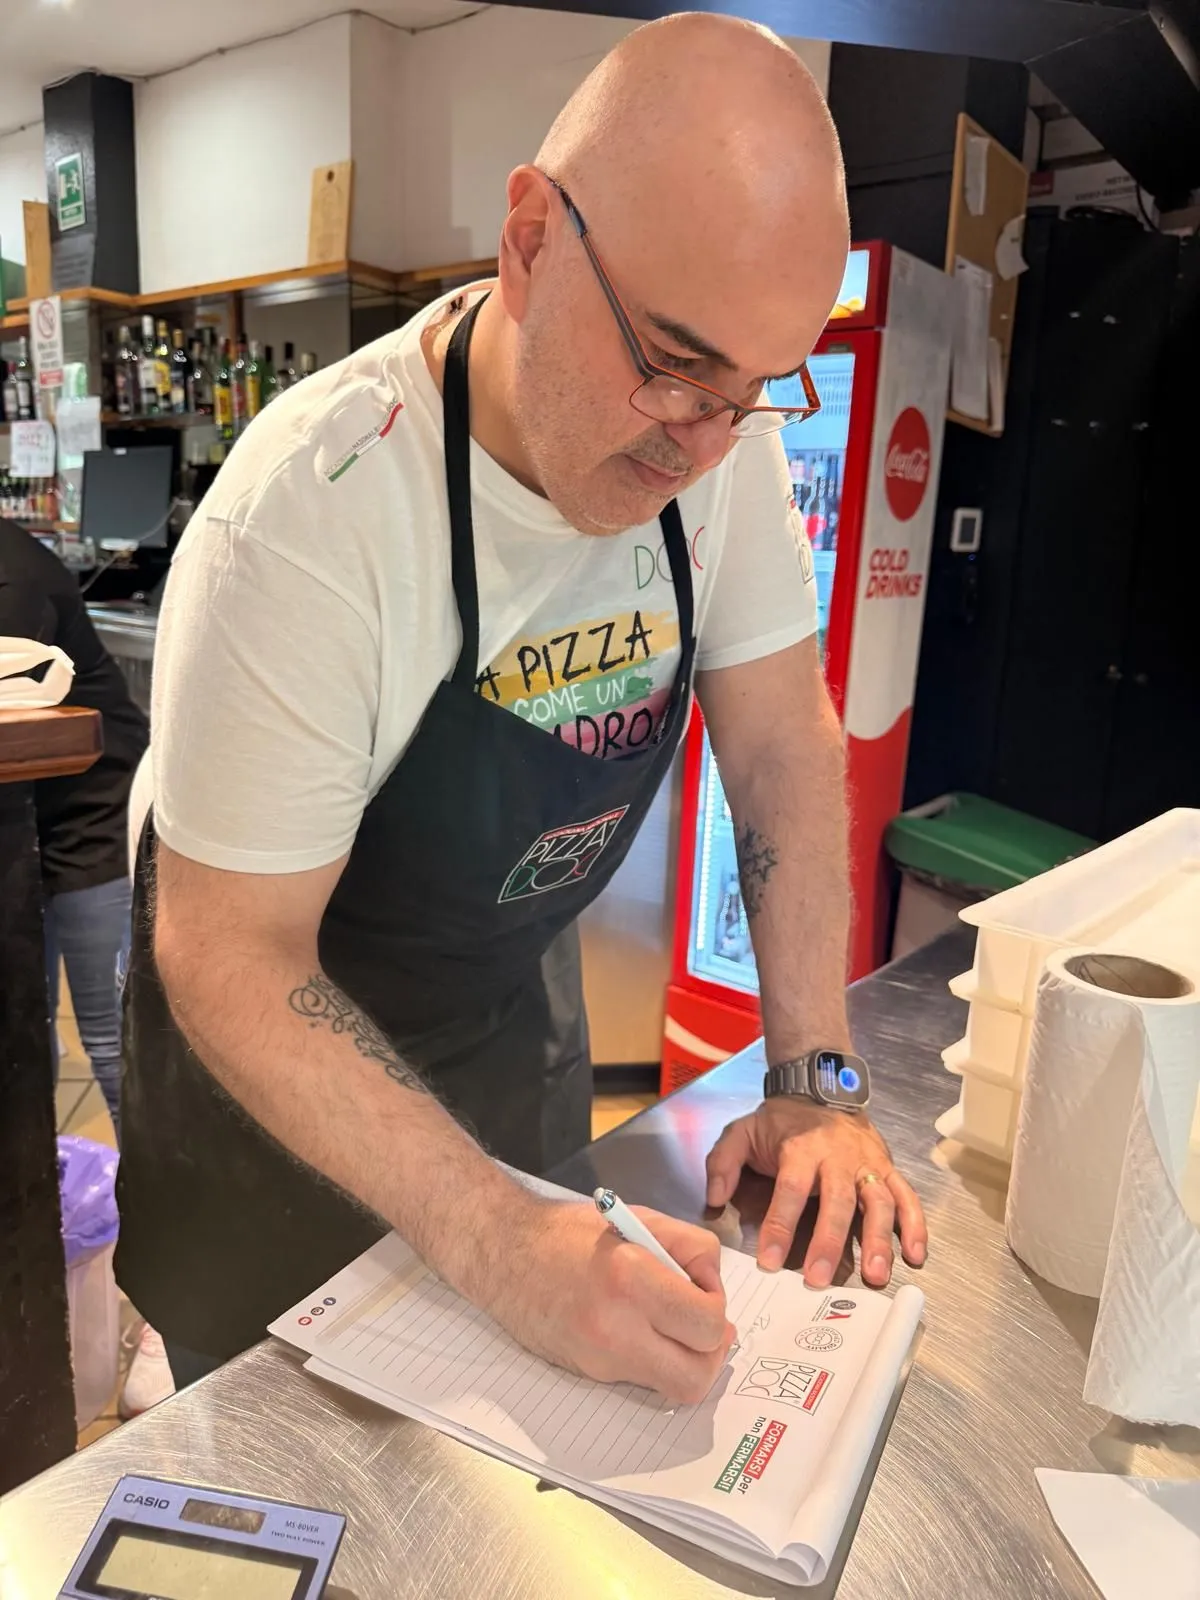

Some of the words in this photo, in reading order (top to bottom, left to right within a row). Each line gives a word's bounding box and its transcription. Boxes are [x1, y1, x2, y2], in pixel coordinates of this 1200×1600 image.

[869, 549, 910, 572] COLD
[866, 574, 923, 599] DRINKS
[516, 610, 653, 693] PIZZA
[513, 683, 588, 724] COME
[595, 674, 628, 706] UN
[521, 821, 609, 867] PIZZA
[504, 848, 603, 898] DOC
[773, 1363, 817, 1400] PIZZA
[751, 1416, 767, 1434] non
[747, 1421, 785, 1476] FORMARSI
[123, 1492, 170, 1510] CASIO
[736, 1473, 753, 1495] per
